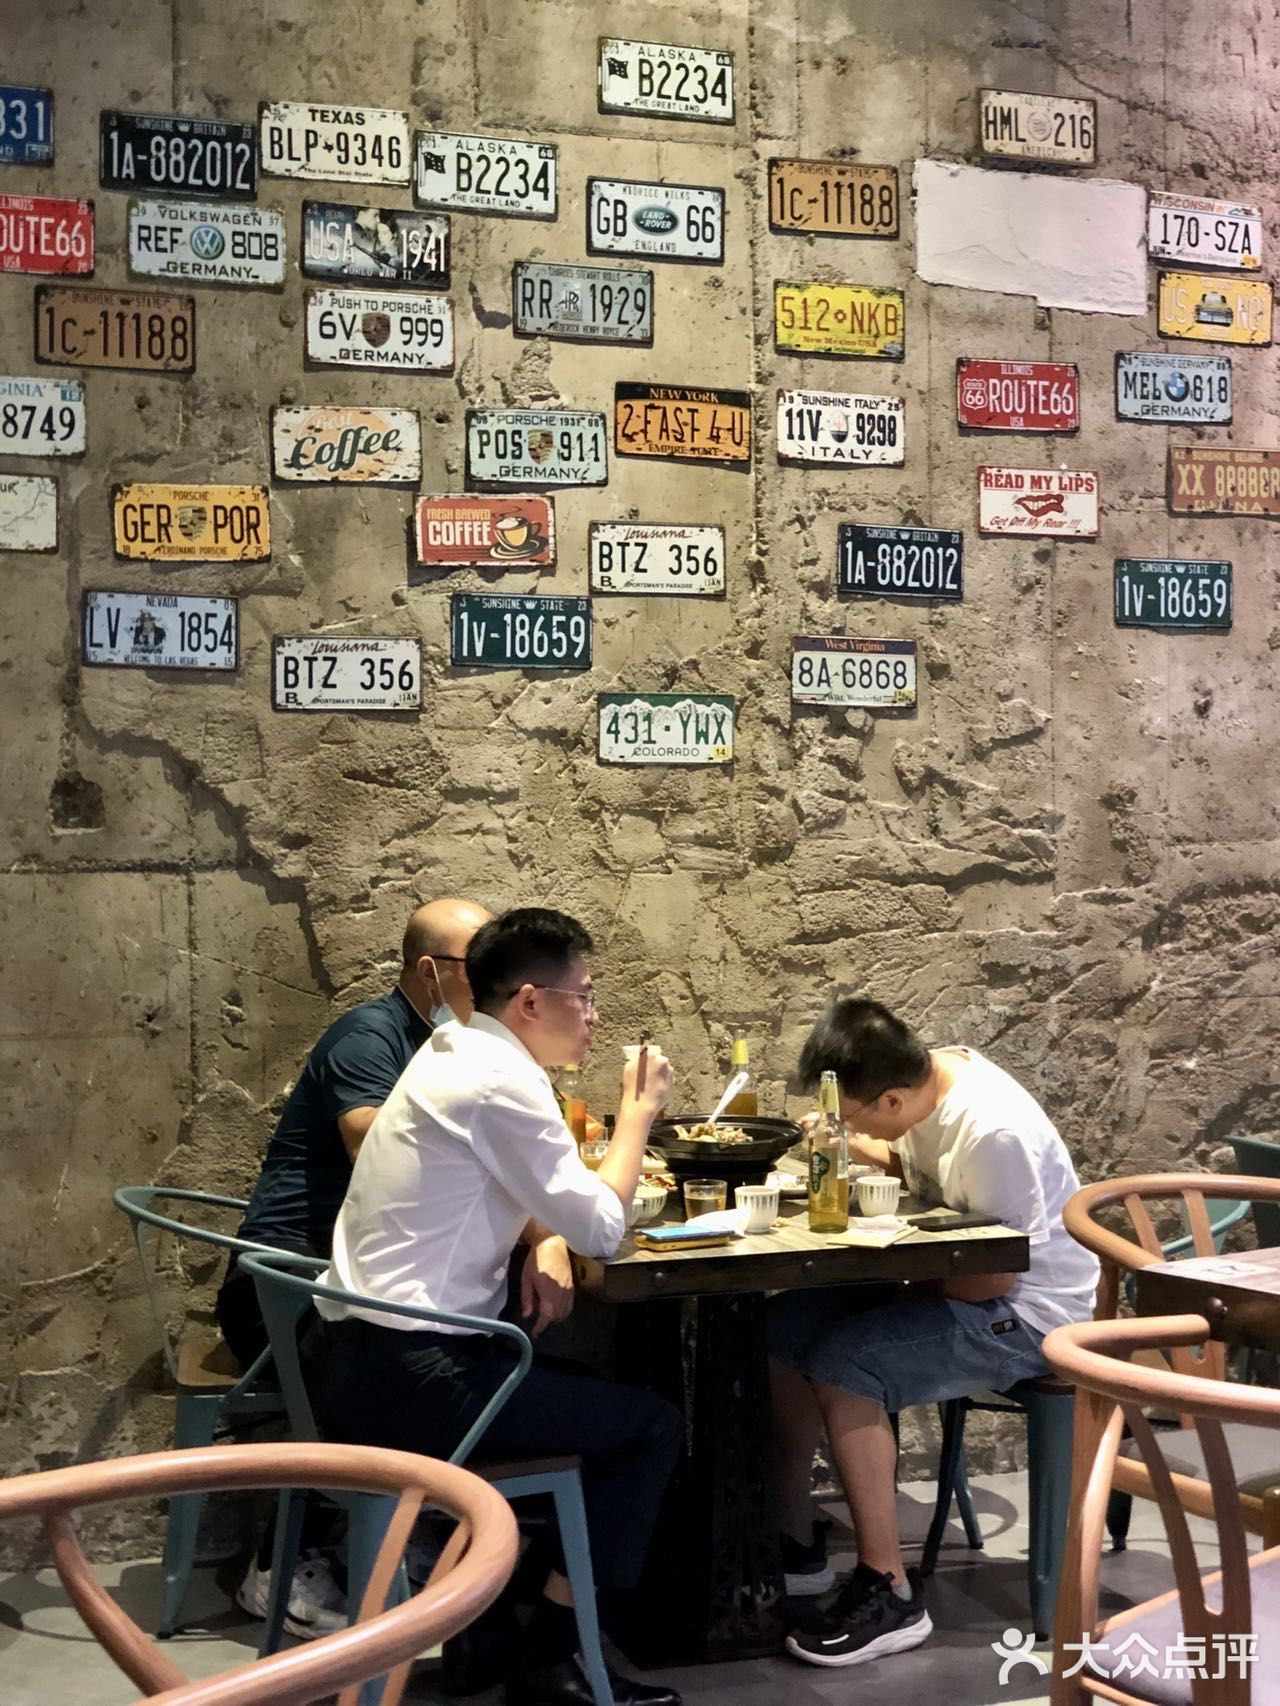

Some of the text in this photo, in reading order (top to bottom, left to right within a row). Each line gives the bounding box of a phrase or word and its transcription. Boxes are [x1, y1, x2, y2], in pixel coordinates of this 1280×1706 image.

[637, 46, 696, 62] ALASKA
[638, 58, 727, 106] B2234
[651, 100, 676, 111] GREAT
[307, 108, 366, 125] TEXAS
[985, 105, 1092, 150] HML 216
[269, 126, 402, 169] BLP 9346
[456, 139, 517, 156] ALASKA
[109, 130, 250, 191] 1A-882012
[456, 152, 550, 201] B2234
[470, 195, 496, 207] GREAT
[1153, 194, 1216, 212] WISCONSIN
[158, 206, 263, 226] VOLKSWAGEN
[596, 196, 628, 238] GB
[687, 205, 715, 243] 66
[137, 224, 279, 262] REF 808
[1161, 212, 1252, 255] 170-SZA
[310, 220, 446, 273] USA 1941
[634, 240, 677, 253] ENGLAND
[166, 261, 254, 279] GERMANY
[330, 296, 434, 315] PUSH TO PORSCHE
[521, 277, 552, 319] RR
[589, 283, 646, 326] 1929
[781, 295, 898, 337] 512 NKB
[318, 311, 444, 348] 6V 999
[339, 348, 426, 365] GERMANY
[650, 387, 720, 403] NEW YORK
[965, 390, 985, 405] 66
[1193, 374, 1228, 404] 618
[801, 395, 881, 410] SUNSHINE ITALY
[1141, 404, 1210, 418] GERMANY
[2, 403, 76, 441] 8749
[496, 414, 557, 427] PORSCHE
[785, 408, 897, 448] 11V 9298
[290, 426, 402, 472] Coffee
[477, 429, 601, 463] POS 911
[811, 446, 873, 460] ITALY
[499, 465, 581, 479] GERMANY
[1177, 463, 1206, 496] XX
[983, 472, 1095, 493] READ MY LIPS
[173, 490, 210, 501] PORSCHE
[427, 508, 491, 521] FRESH BREWED
[122, 503, 262, 546] GER POR
[428, 520, 492, 546] COFFEE
[624, 526, 691, 542] Louisiana
[598, 541, 718, 577] BTZ 356
[845, 540, 958, 590] 1A-882012
[600, 576, 612, 587] B
[146, 596, 179, 609] NEVADA
[481, 598, 565, 612] SUNSHINE STATE
[88, 606, 234, 654] LV 1854
[311, 641, 387, 656] Louisiana
[824, 639, 886, 653] West Virginia
[284, 655, 414, 691] BTZ 356
[285, 692, 298, 704] B
[606, 711, 727, 745] 431 YWX
[633, 747, 700, 757] COLORADO
[715, 747, 726, 756] 14
